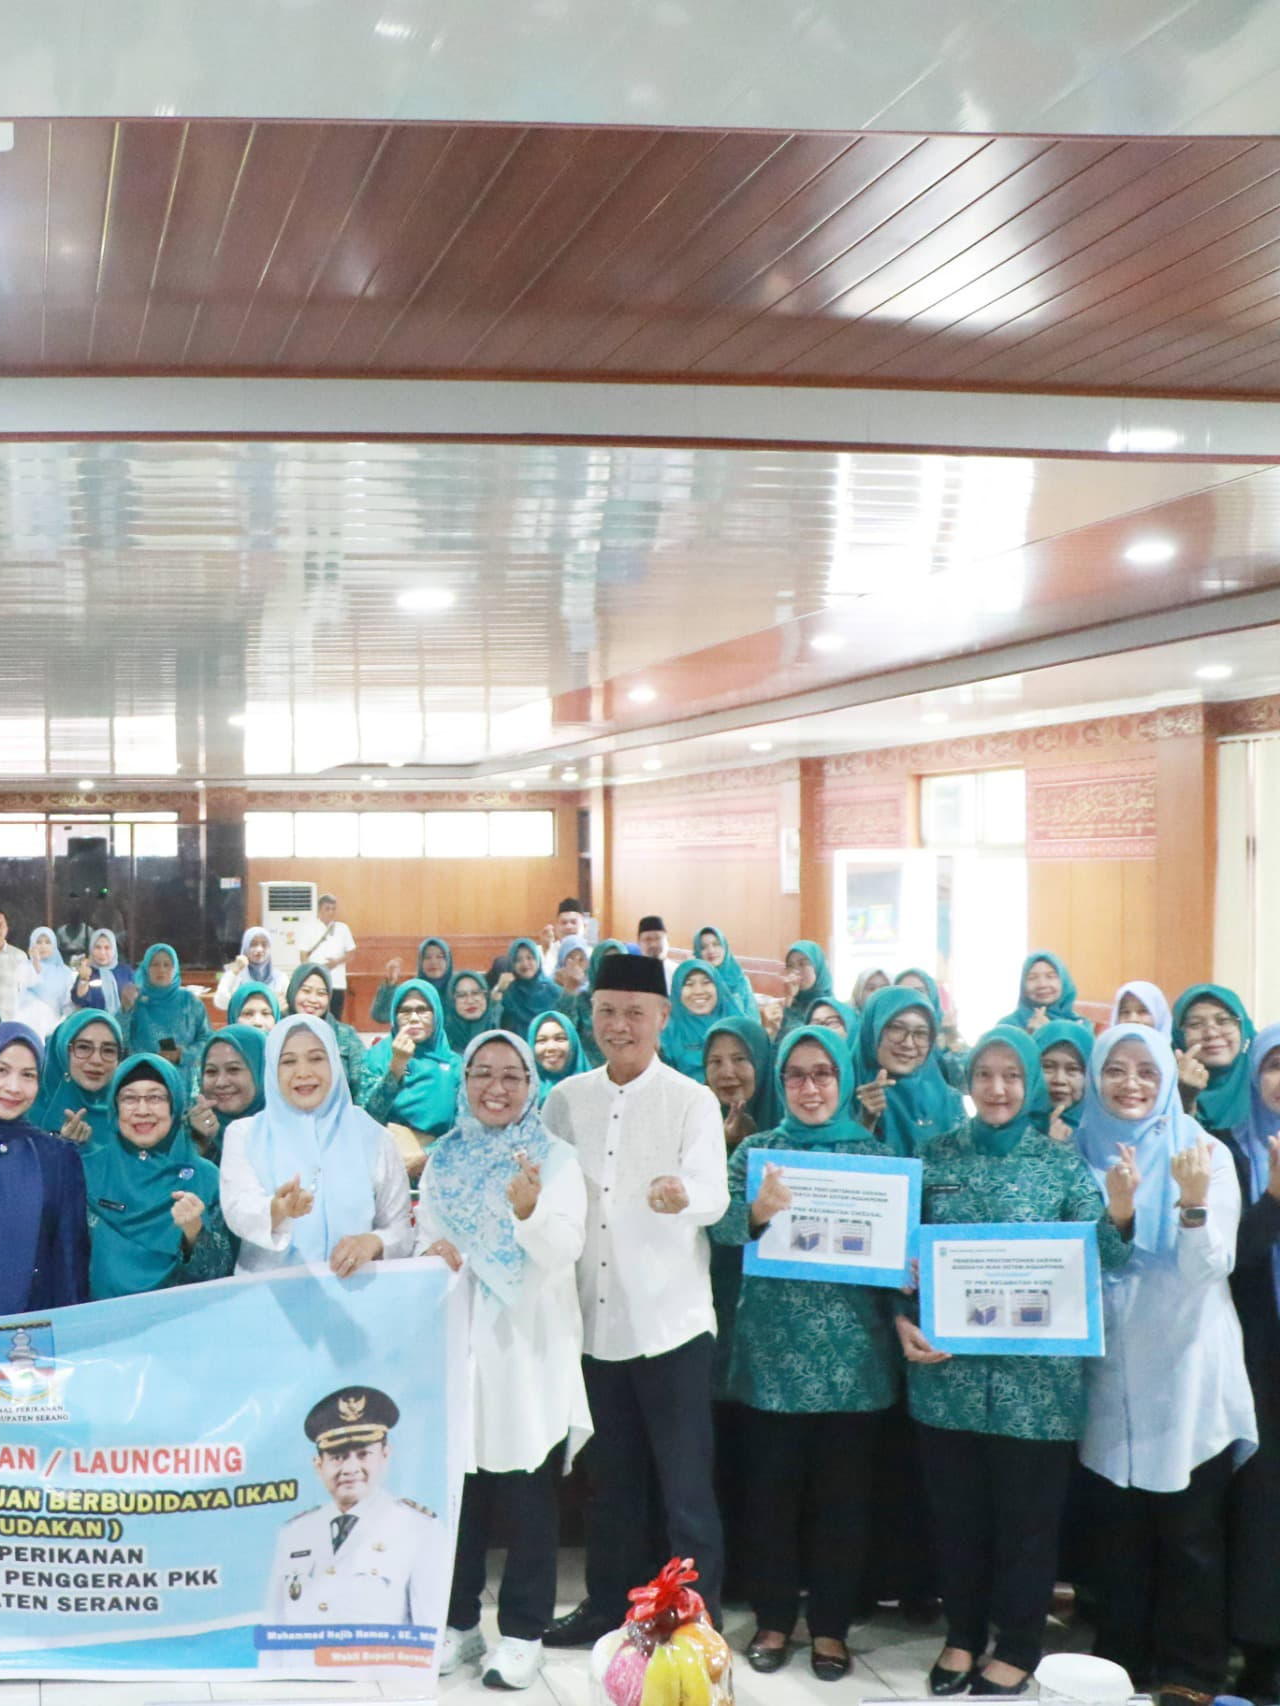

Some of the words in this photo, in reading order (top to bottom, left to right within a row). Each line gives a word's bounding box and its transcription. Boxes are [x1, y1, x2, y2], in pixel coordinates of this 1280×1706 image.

[35, 1414, 69, 1422] SERANG
[44, 1450, 62, 1477] /
[74, 1446, 243, 1474] LAUNCHING
[46, 1488, 231, 1515] BERBUDIDAYA
[235, 1479, 298, 1507] IKAN
[5, 1570, 158, 1589] PENGGERAK
[168, 1568, 218, 1587] PKK
[57, 1595, 160, 1612] SERANG
